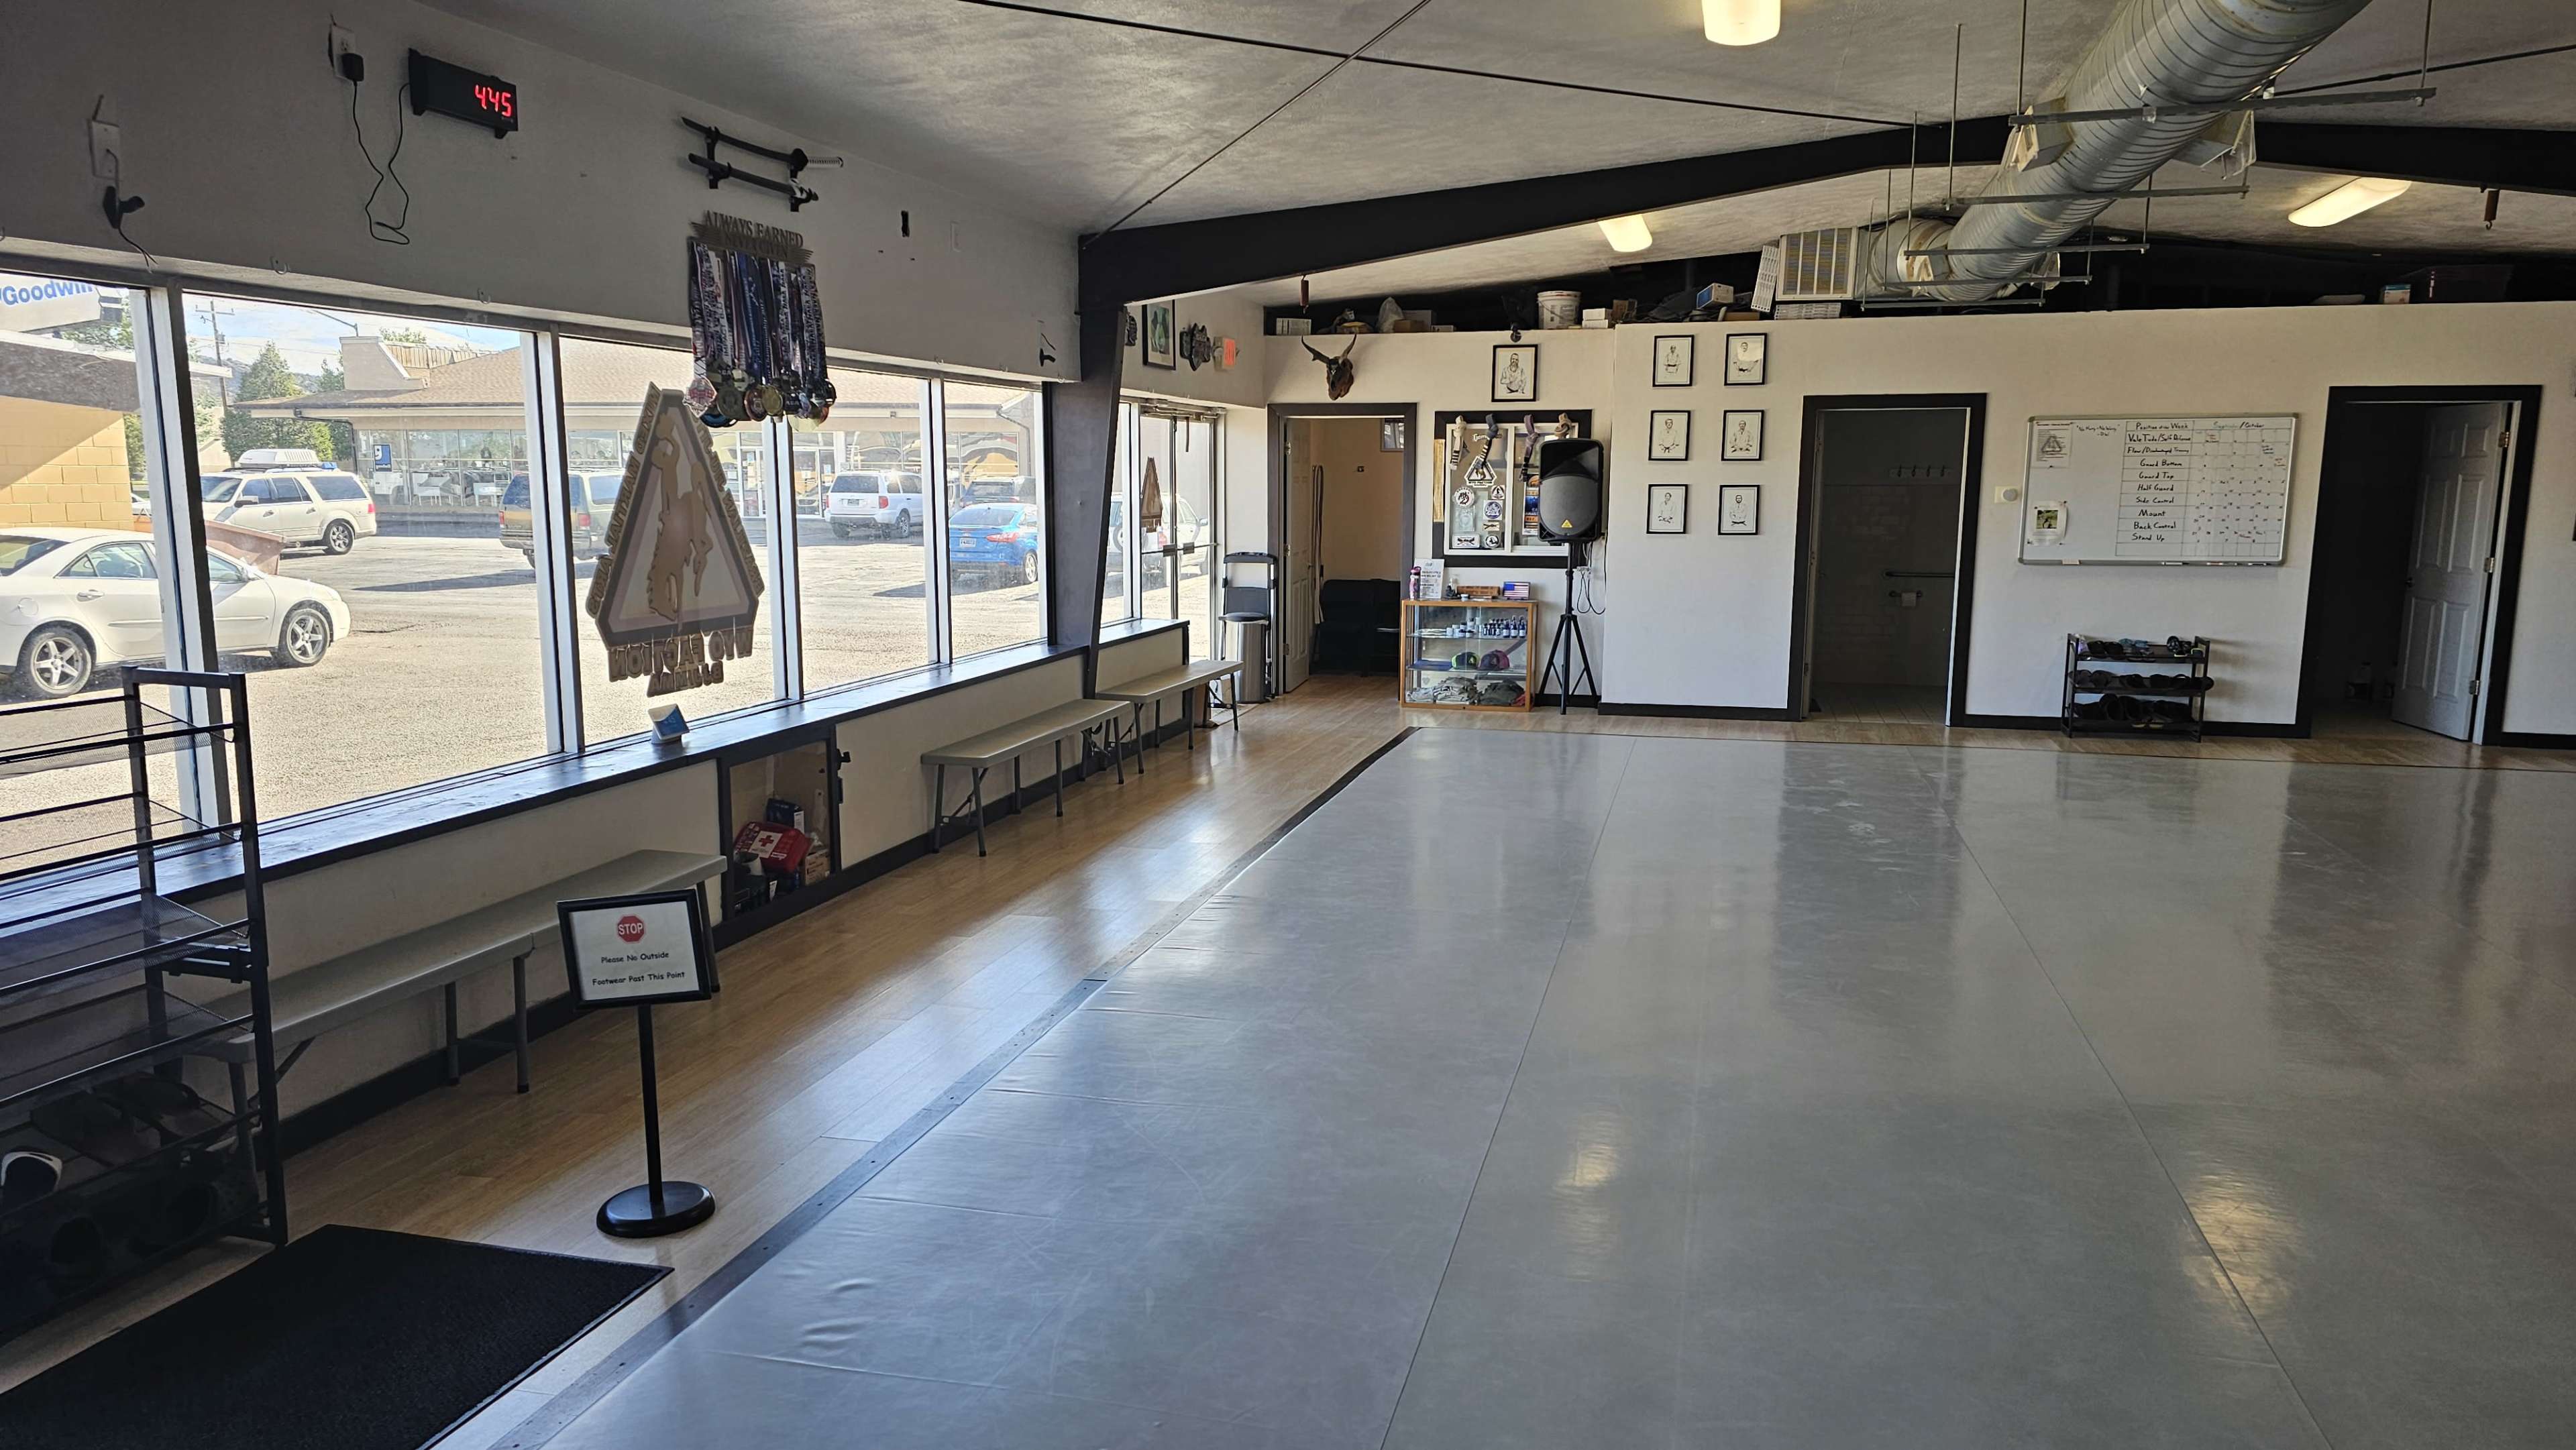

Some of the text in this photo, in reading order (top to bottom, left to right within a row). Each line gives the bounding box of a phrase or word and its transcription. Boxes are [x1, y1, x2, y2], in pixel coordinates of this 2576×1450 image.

[705, 210, 804, 247] ALWAYS EARNED
[2153, 521, 2176, 529] Control
[618, 922, 643, 936] STOP
[601, 955, 624, 964] Please
[641, 951, 669, 960] Outside
[592, 977, 626, 985] Footwear
[647, 972, 664, 981] This
[667, 971, 685, 979] Point
